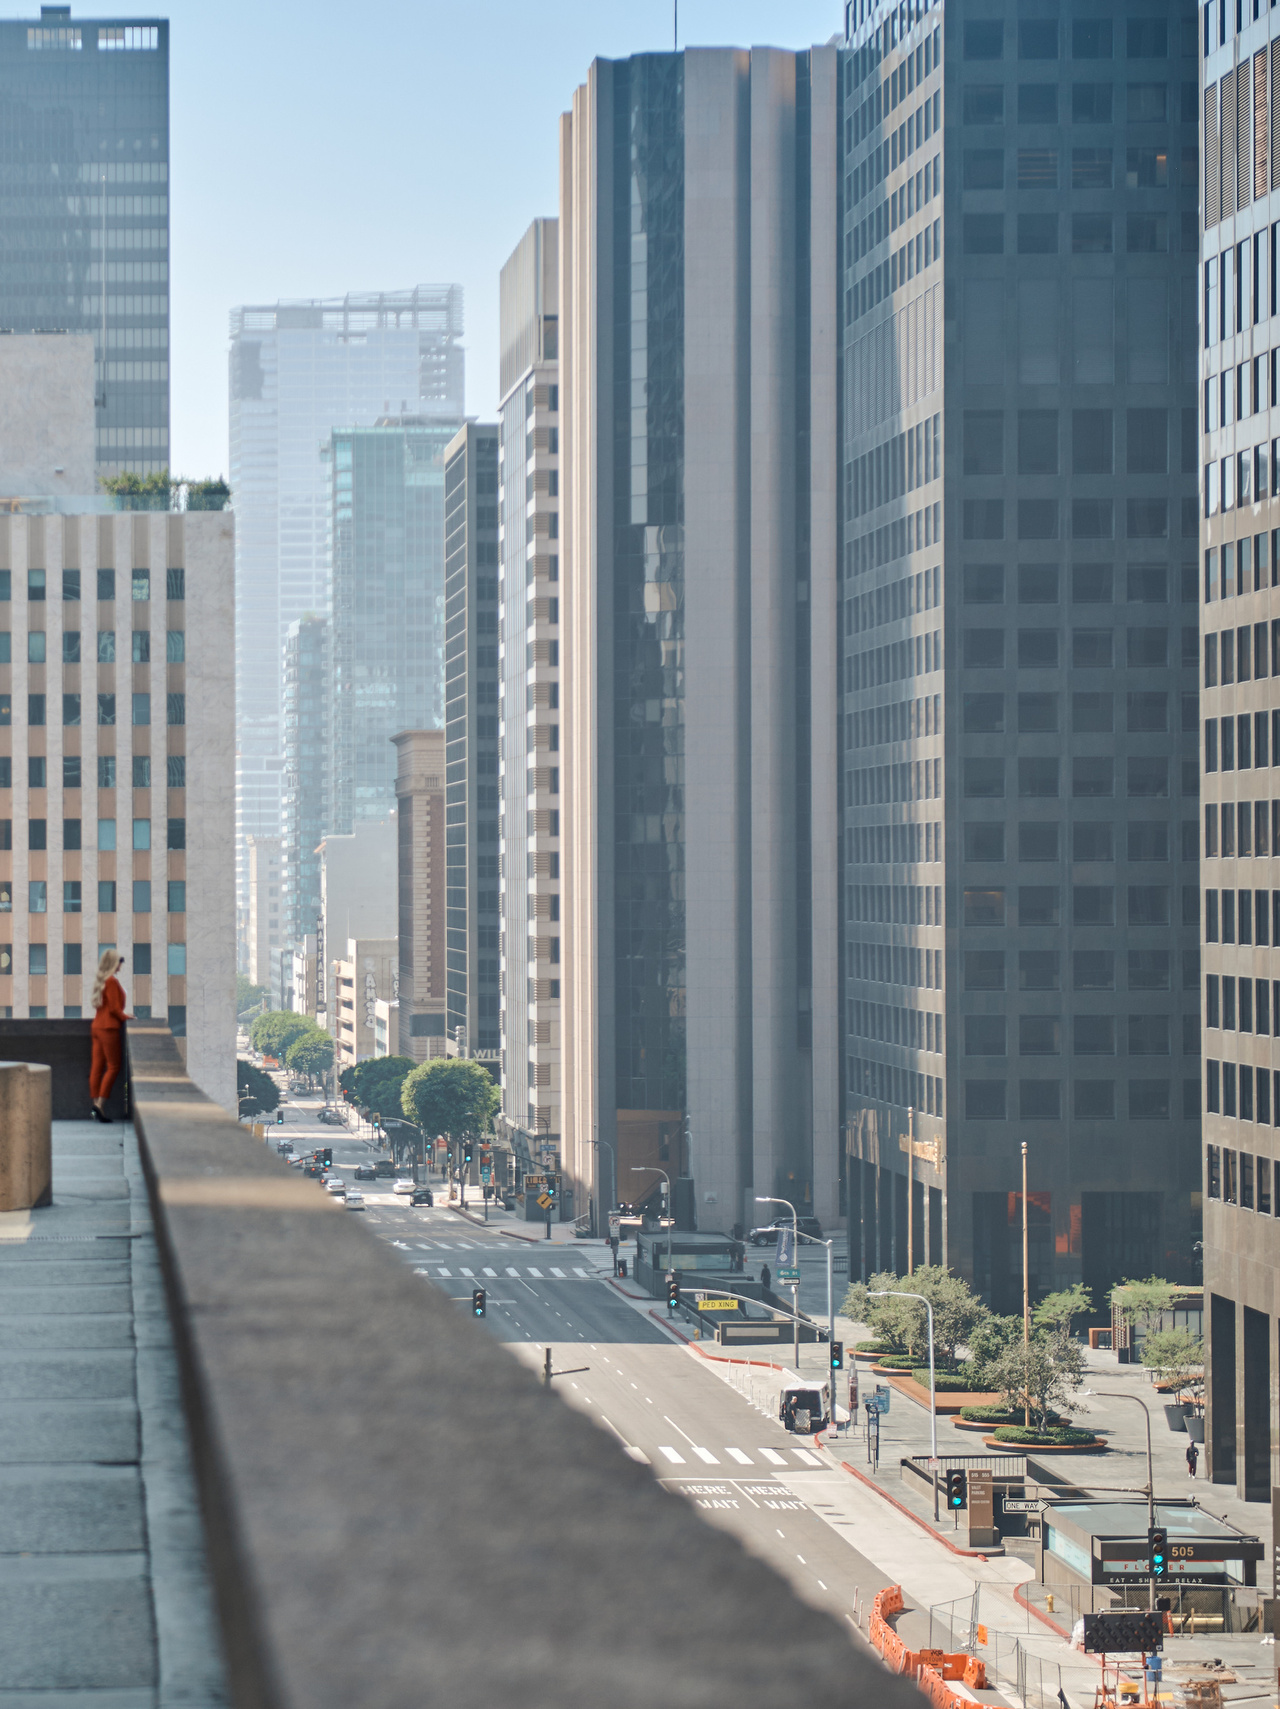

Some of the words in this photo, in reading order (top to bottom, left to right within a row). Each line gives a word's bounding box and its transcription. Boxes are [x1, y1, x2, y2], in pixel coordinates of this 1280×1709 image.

[702, 1301, 716, 1309] PED
[718, 1300, 735, 1308] XING
[679, 1485, 732, 1495] HERE
[744, 1486, 797, 1496] HERE
[696, 1499, 740, 1509] WAIT
[764, 1500, 808, 1510] WAIT
[1171, 1546, 1194, 1557] 505
[1124, 1563, 1185, 1571] FLOER
